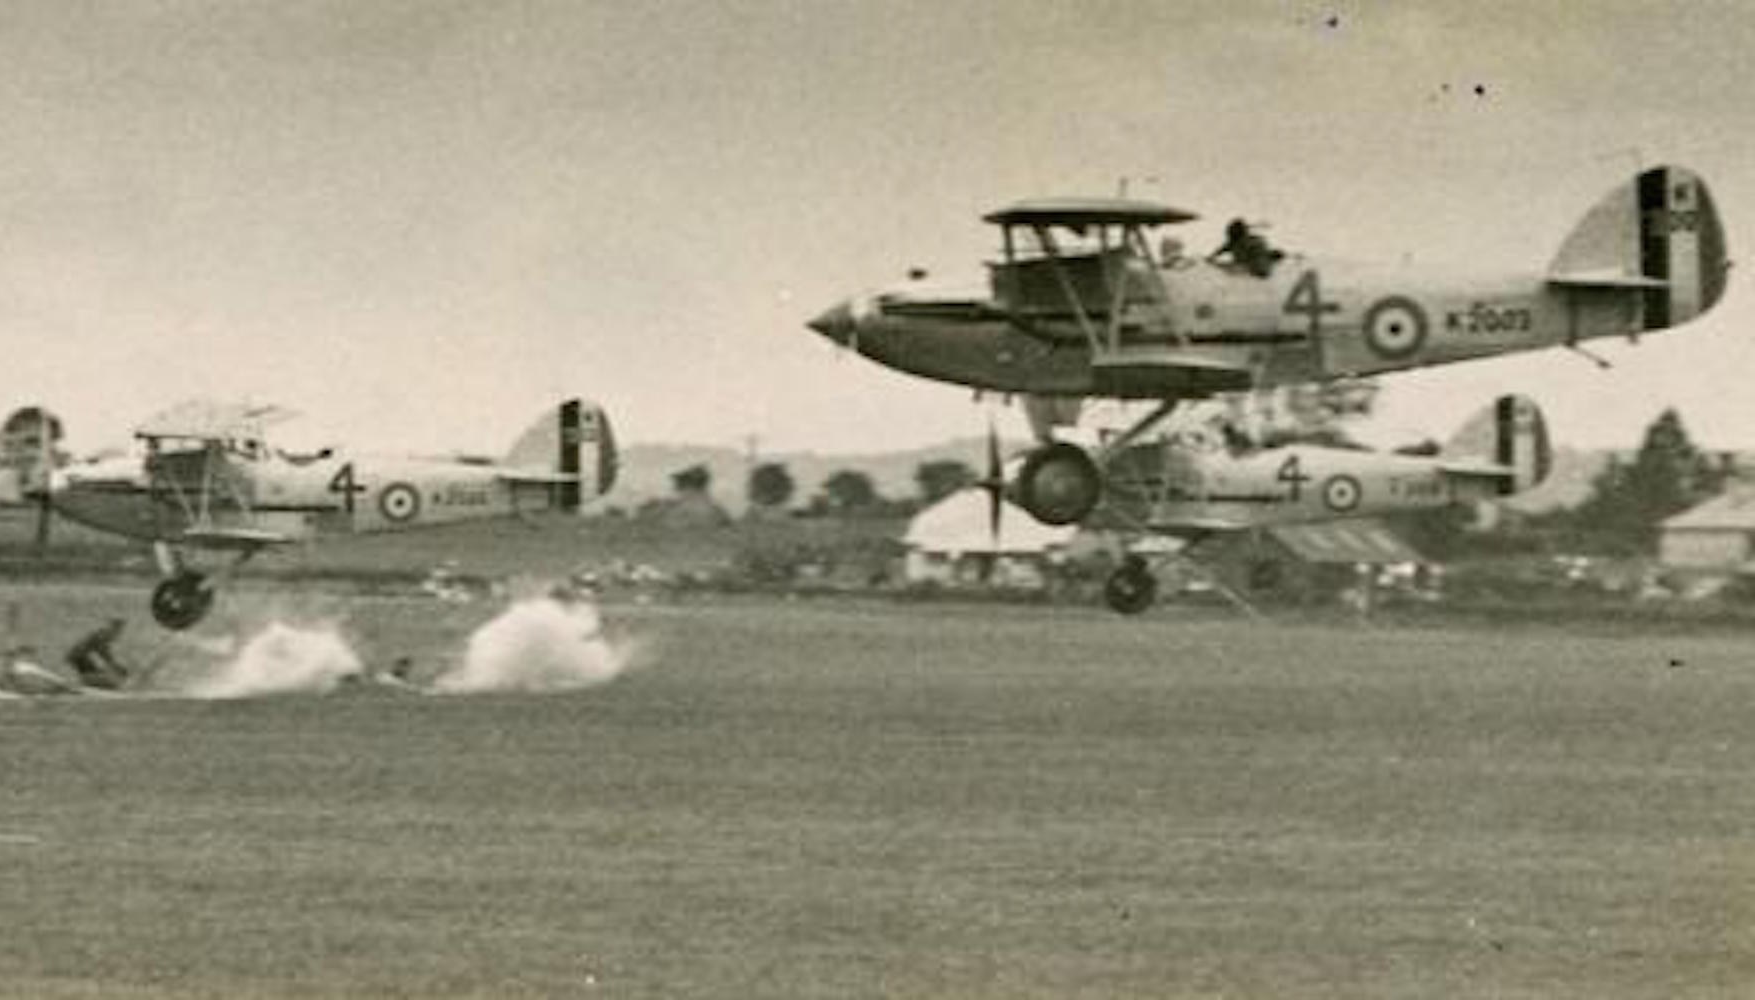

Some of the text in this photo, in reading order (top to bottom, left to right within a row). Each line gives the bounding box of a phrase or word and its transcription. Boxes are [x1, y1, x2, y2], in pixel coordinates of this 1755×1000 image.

[1282, 270, 1340, 356] 4
[329, 463, 366, 512] 4
[1278, 455, 1311, 501] 4
